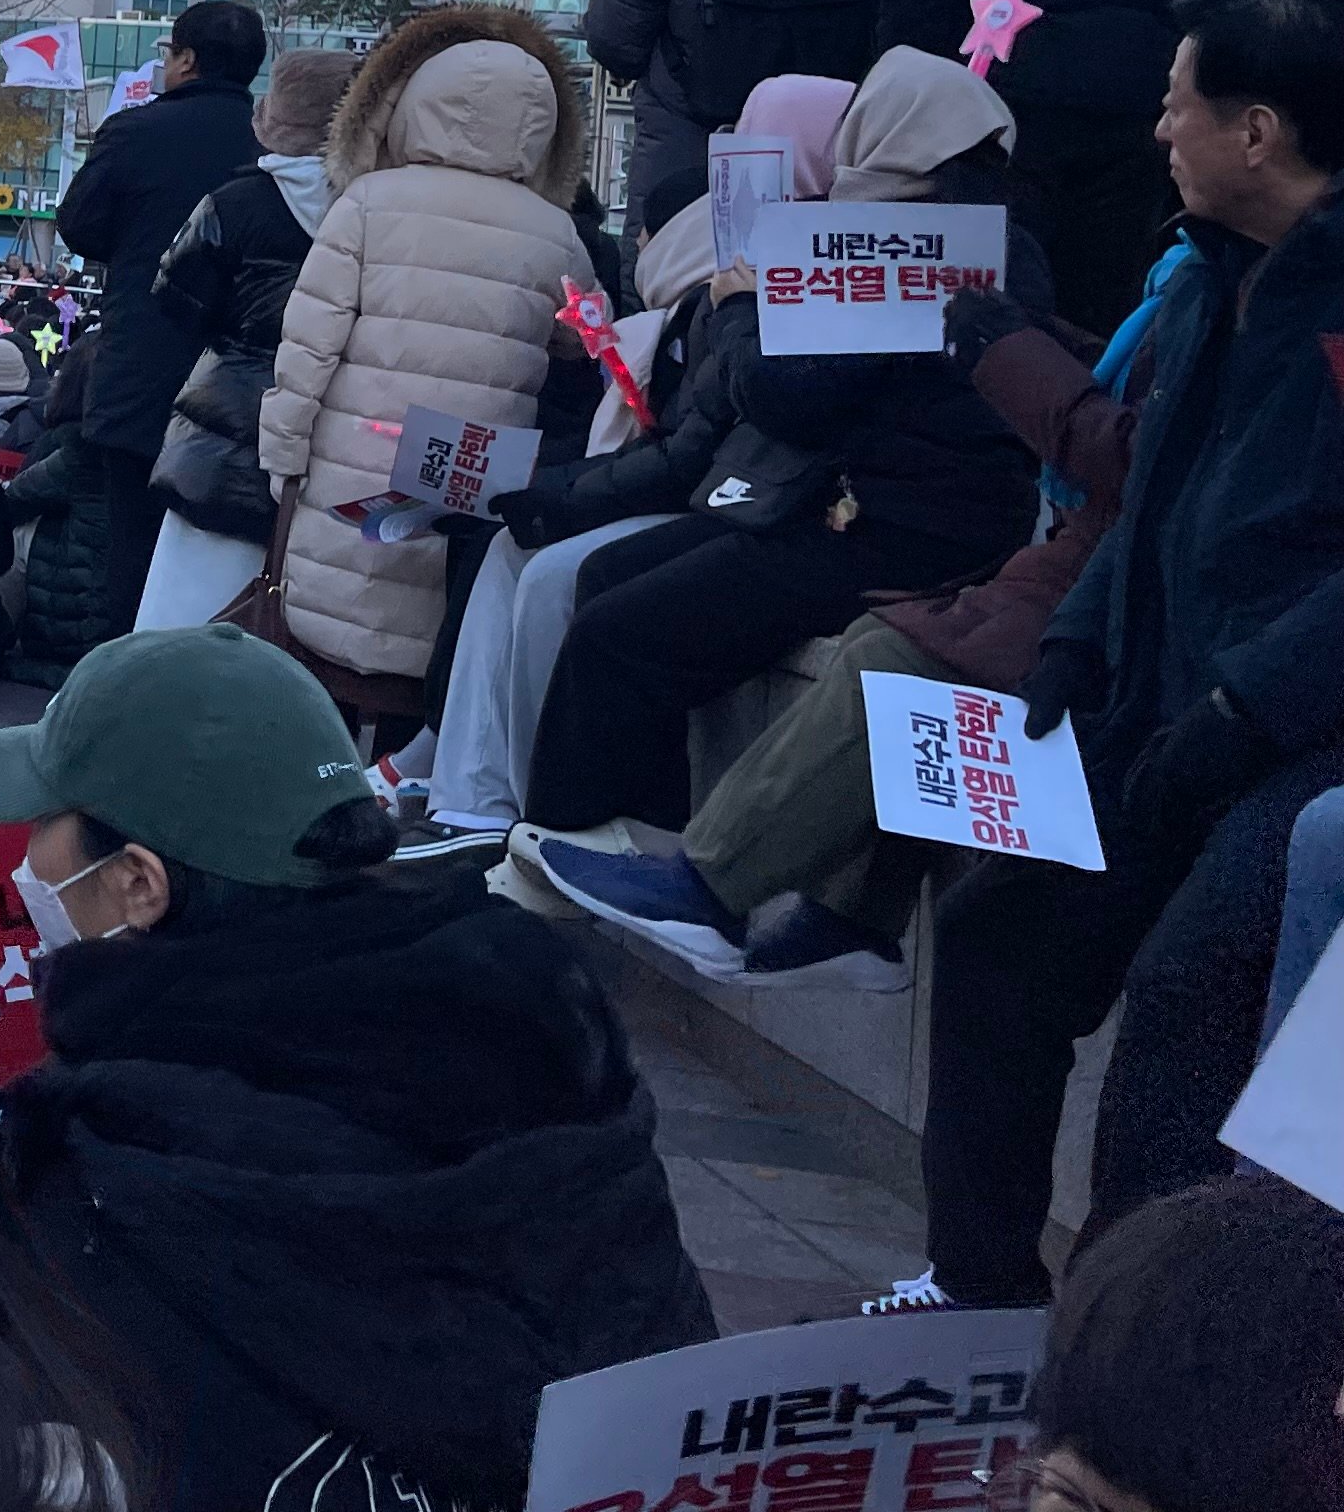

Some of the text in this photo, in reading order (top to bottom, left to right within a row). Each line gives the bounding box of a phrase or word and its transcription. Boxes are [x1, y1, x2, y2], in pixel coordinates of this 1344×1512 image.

[810, 231, 945, 262] 내란수괴
[763, 265, 887, 306] 윤석열
[418, 436, 454, 490] 내란수괴
[443, 421, 497, 514] 윤석열 탄핵!
[909, 709, 961, 810] 내란수괴
[952, 688, 1032, 853] 윤석열 탄핵!
